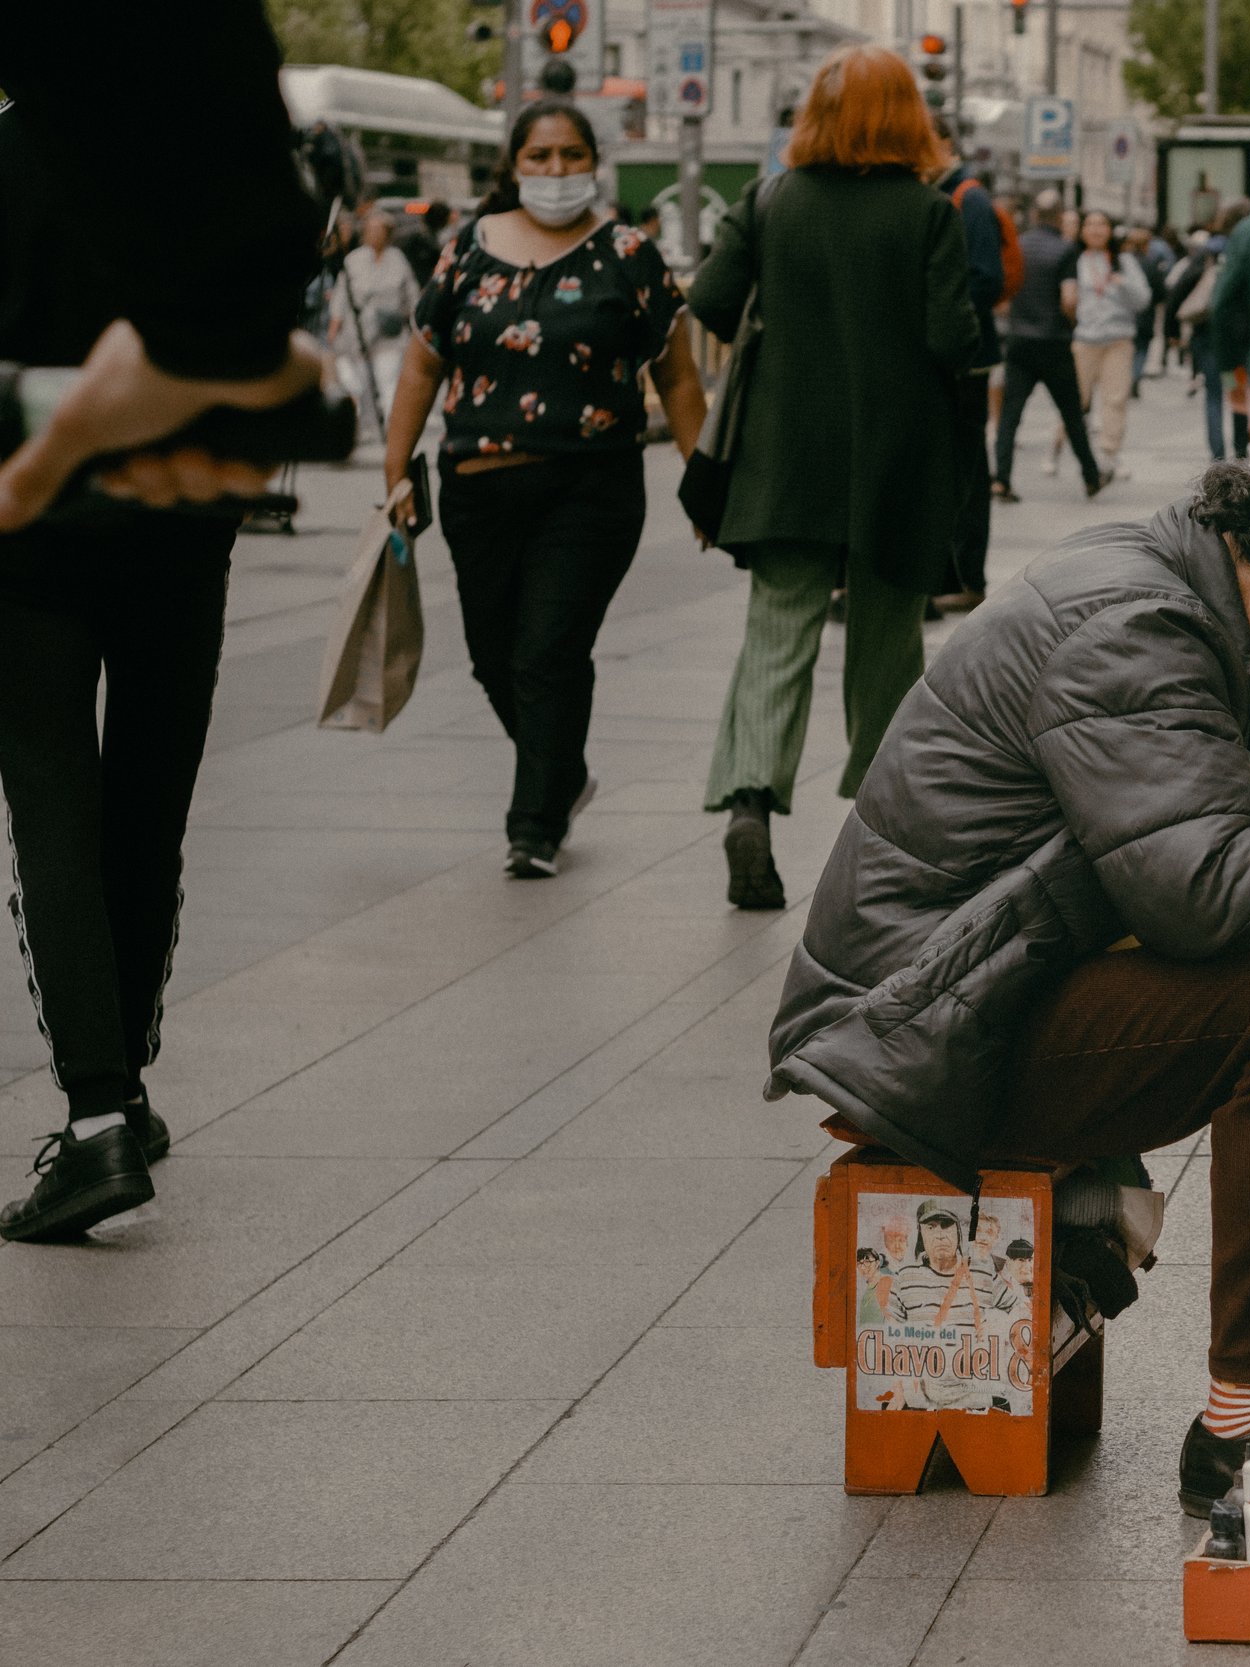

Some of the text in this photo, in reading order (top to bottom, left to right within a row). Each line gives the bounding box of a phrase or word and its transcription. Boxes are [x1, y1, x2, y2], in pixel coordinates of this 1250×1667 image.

[857, 1319, 1033, 1392] Chavo del 8
[888, 1326, 956, 1341] Lo Mejor del
